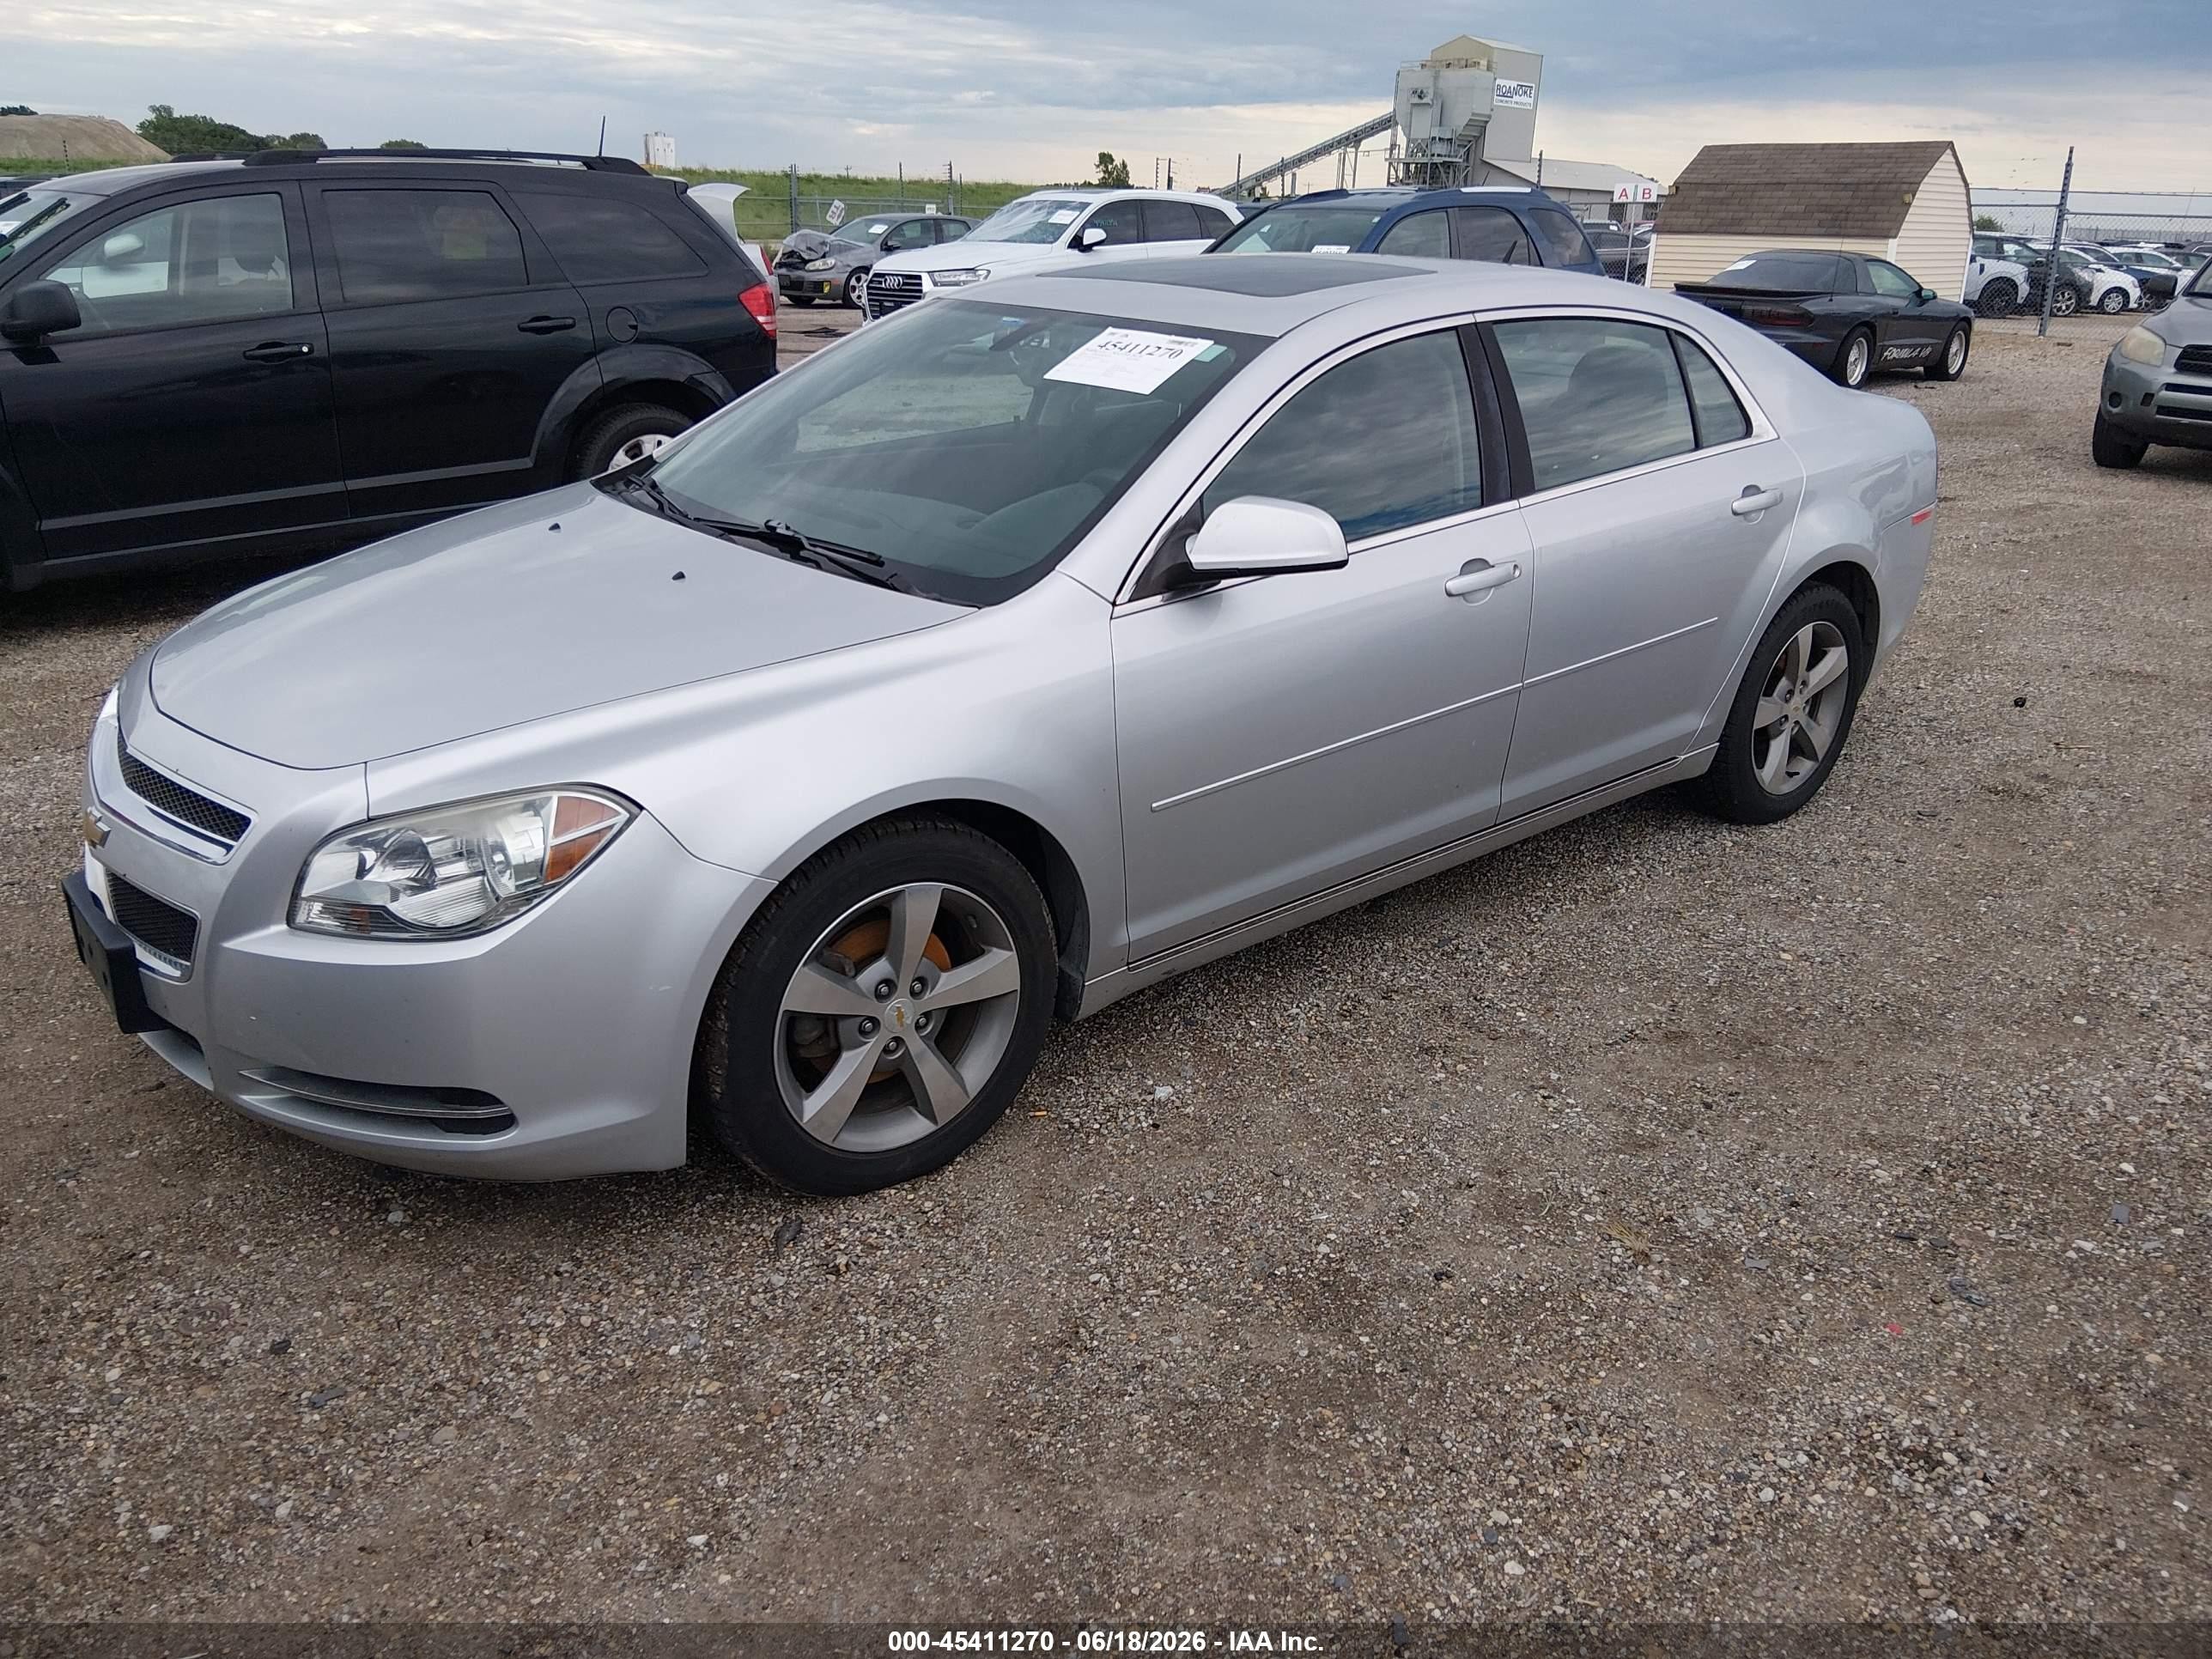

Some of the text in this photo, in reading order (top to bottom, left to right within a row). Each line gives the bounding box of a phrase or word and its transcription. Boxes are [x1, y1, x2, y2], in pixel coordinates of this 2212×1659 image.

[1496, 84, 1533, 98] ROANOKE
[1618, 187, 1652, 200] A B
[1097, 341, 1184, 359] 45411270
